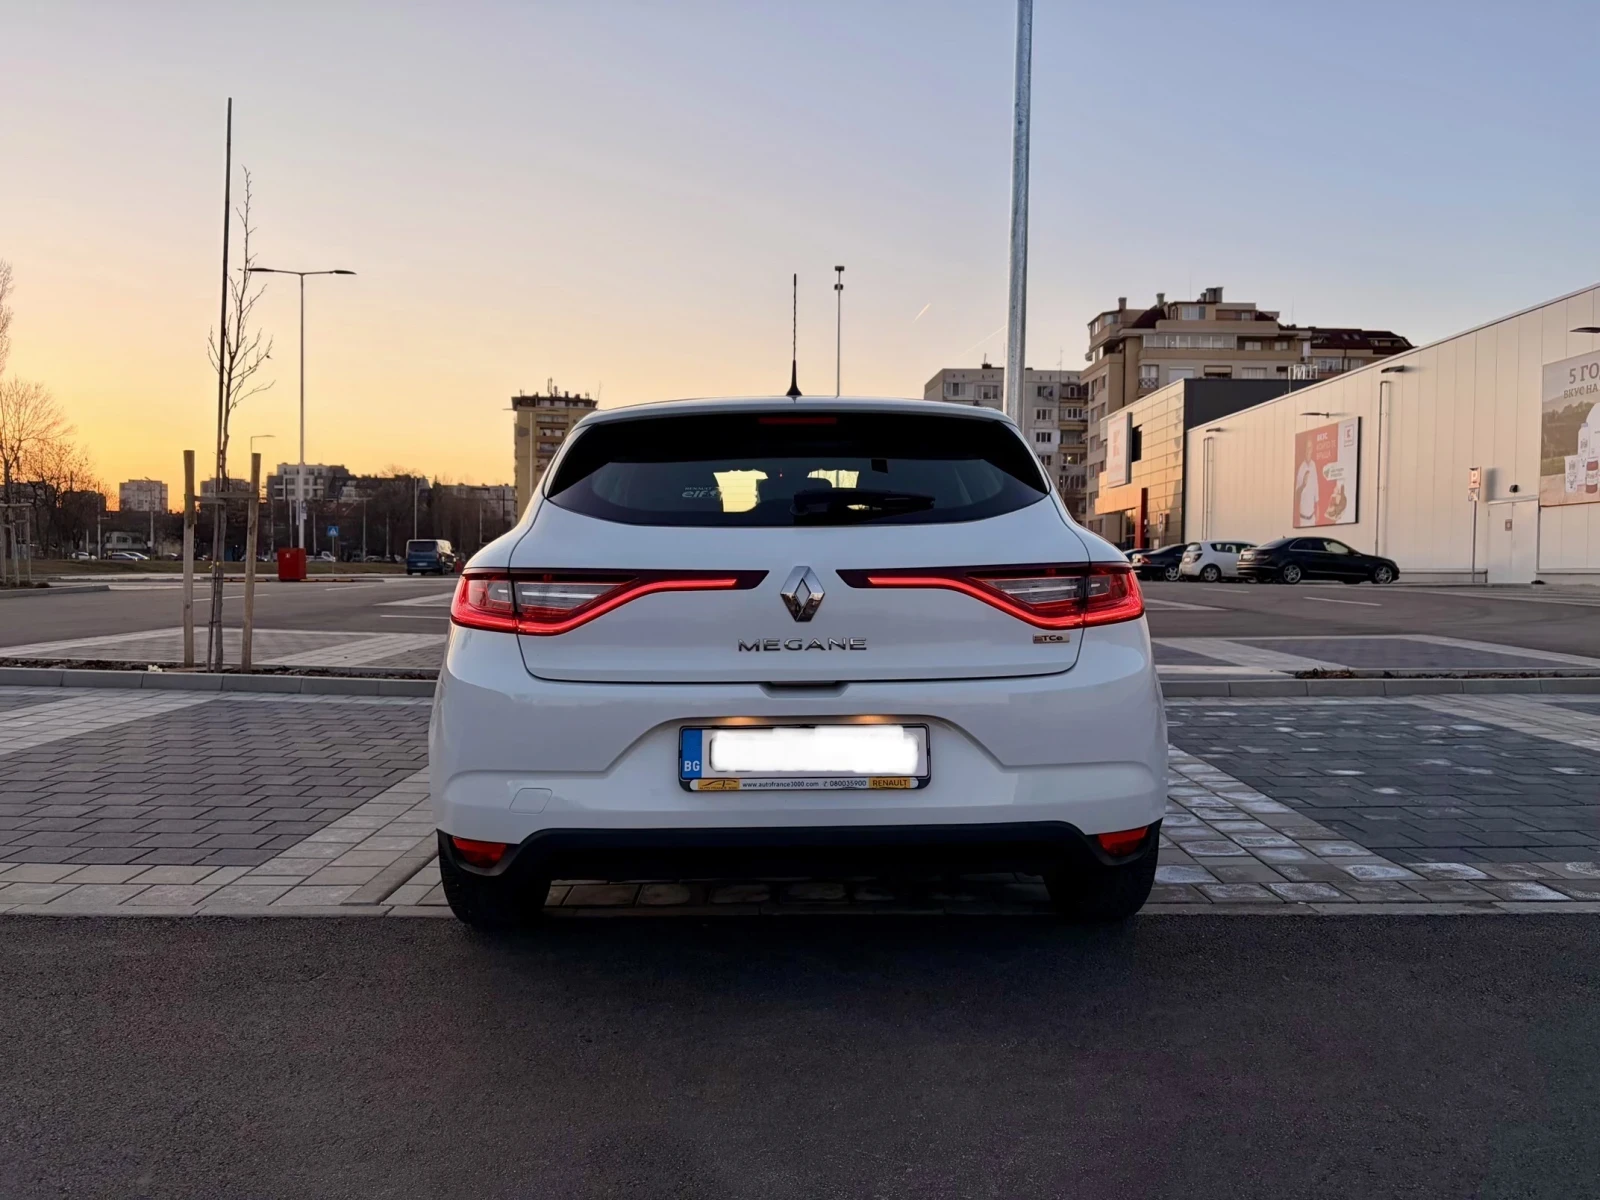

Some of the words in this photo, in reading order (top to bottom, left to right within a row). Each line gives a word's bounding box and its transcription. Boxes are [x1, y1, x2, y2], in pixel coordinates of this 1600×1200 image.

[1569, 368, 1576, 384] 5
[1580, 363, 1600, 382] ГО
[1564, 386, 1584, 399] ВКУС
[1586, 384, 1598, 394] НА
[738, 638, 867, 652] MEGANE
[684, 760, 700, 772] BG
